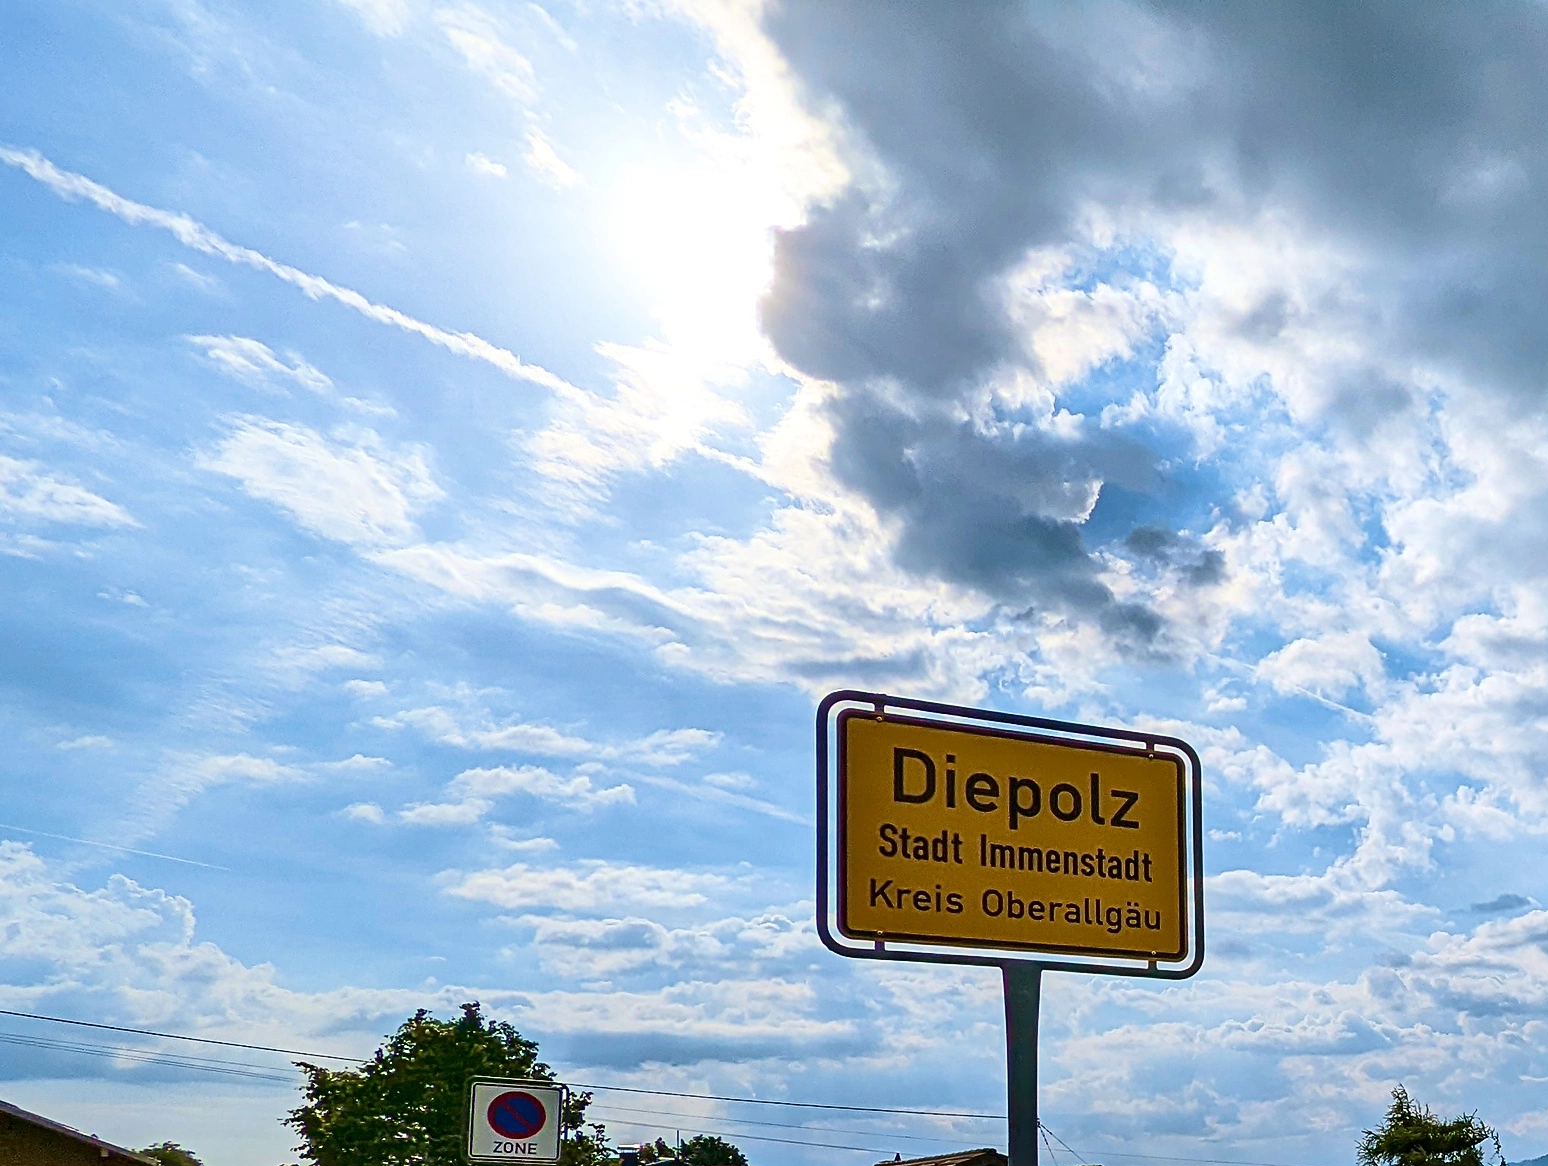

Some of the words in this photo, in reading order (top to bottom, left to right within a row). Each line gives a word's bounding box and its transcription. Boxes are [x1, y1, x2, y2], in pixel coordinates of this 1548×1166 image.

[893, 747, 1139, 830] Diepolz
[879, 823, 963, 865] Stadt
[981, 834, 1153, 883] Immenstadt
[869, 878, 964, 914] Kreis
[981, 889, 1162, 934] Oberallgäu
[493, 1141, 538, 1155] ZONE
